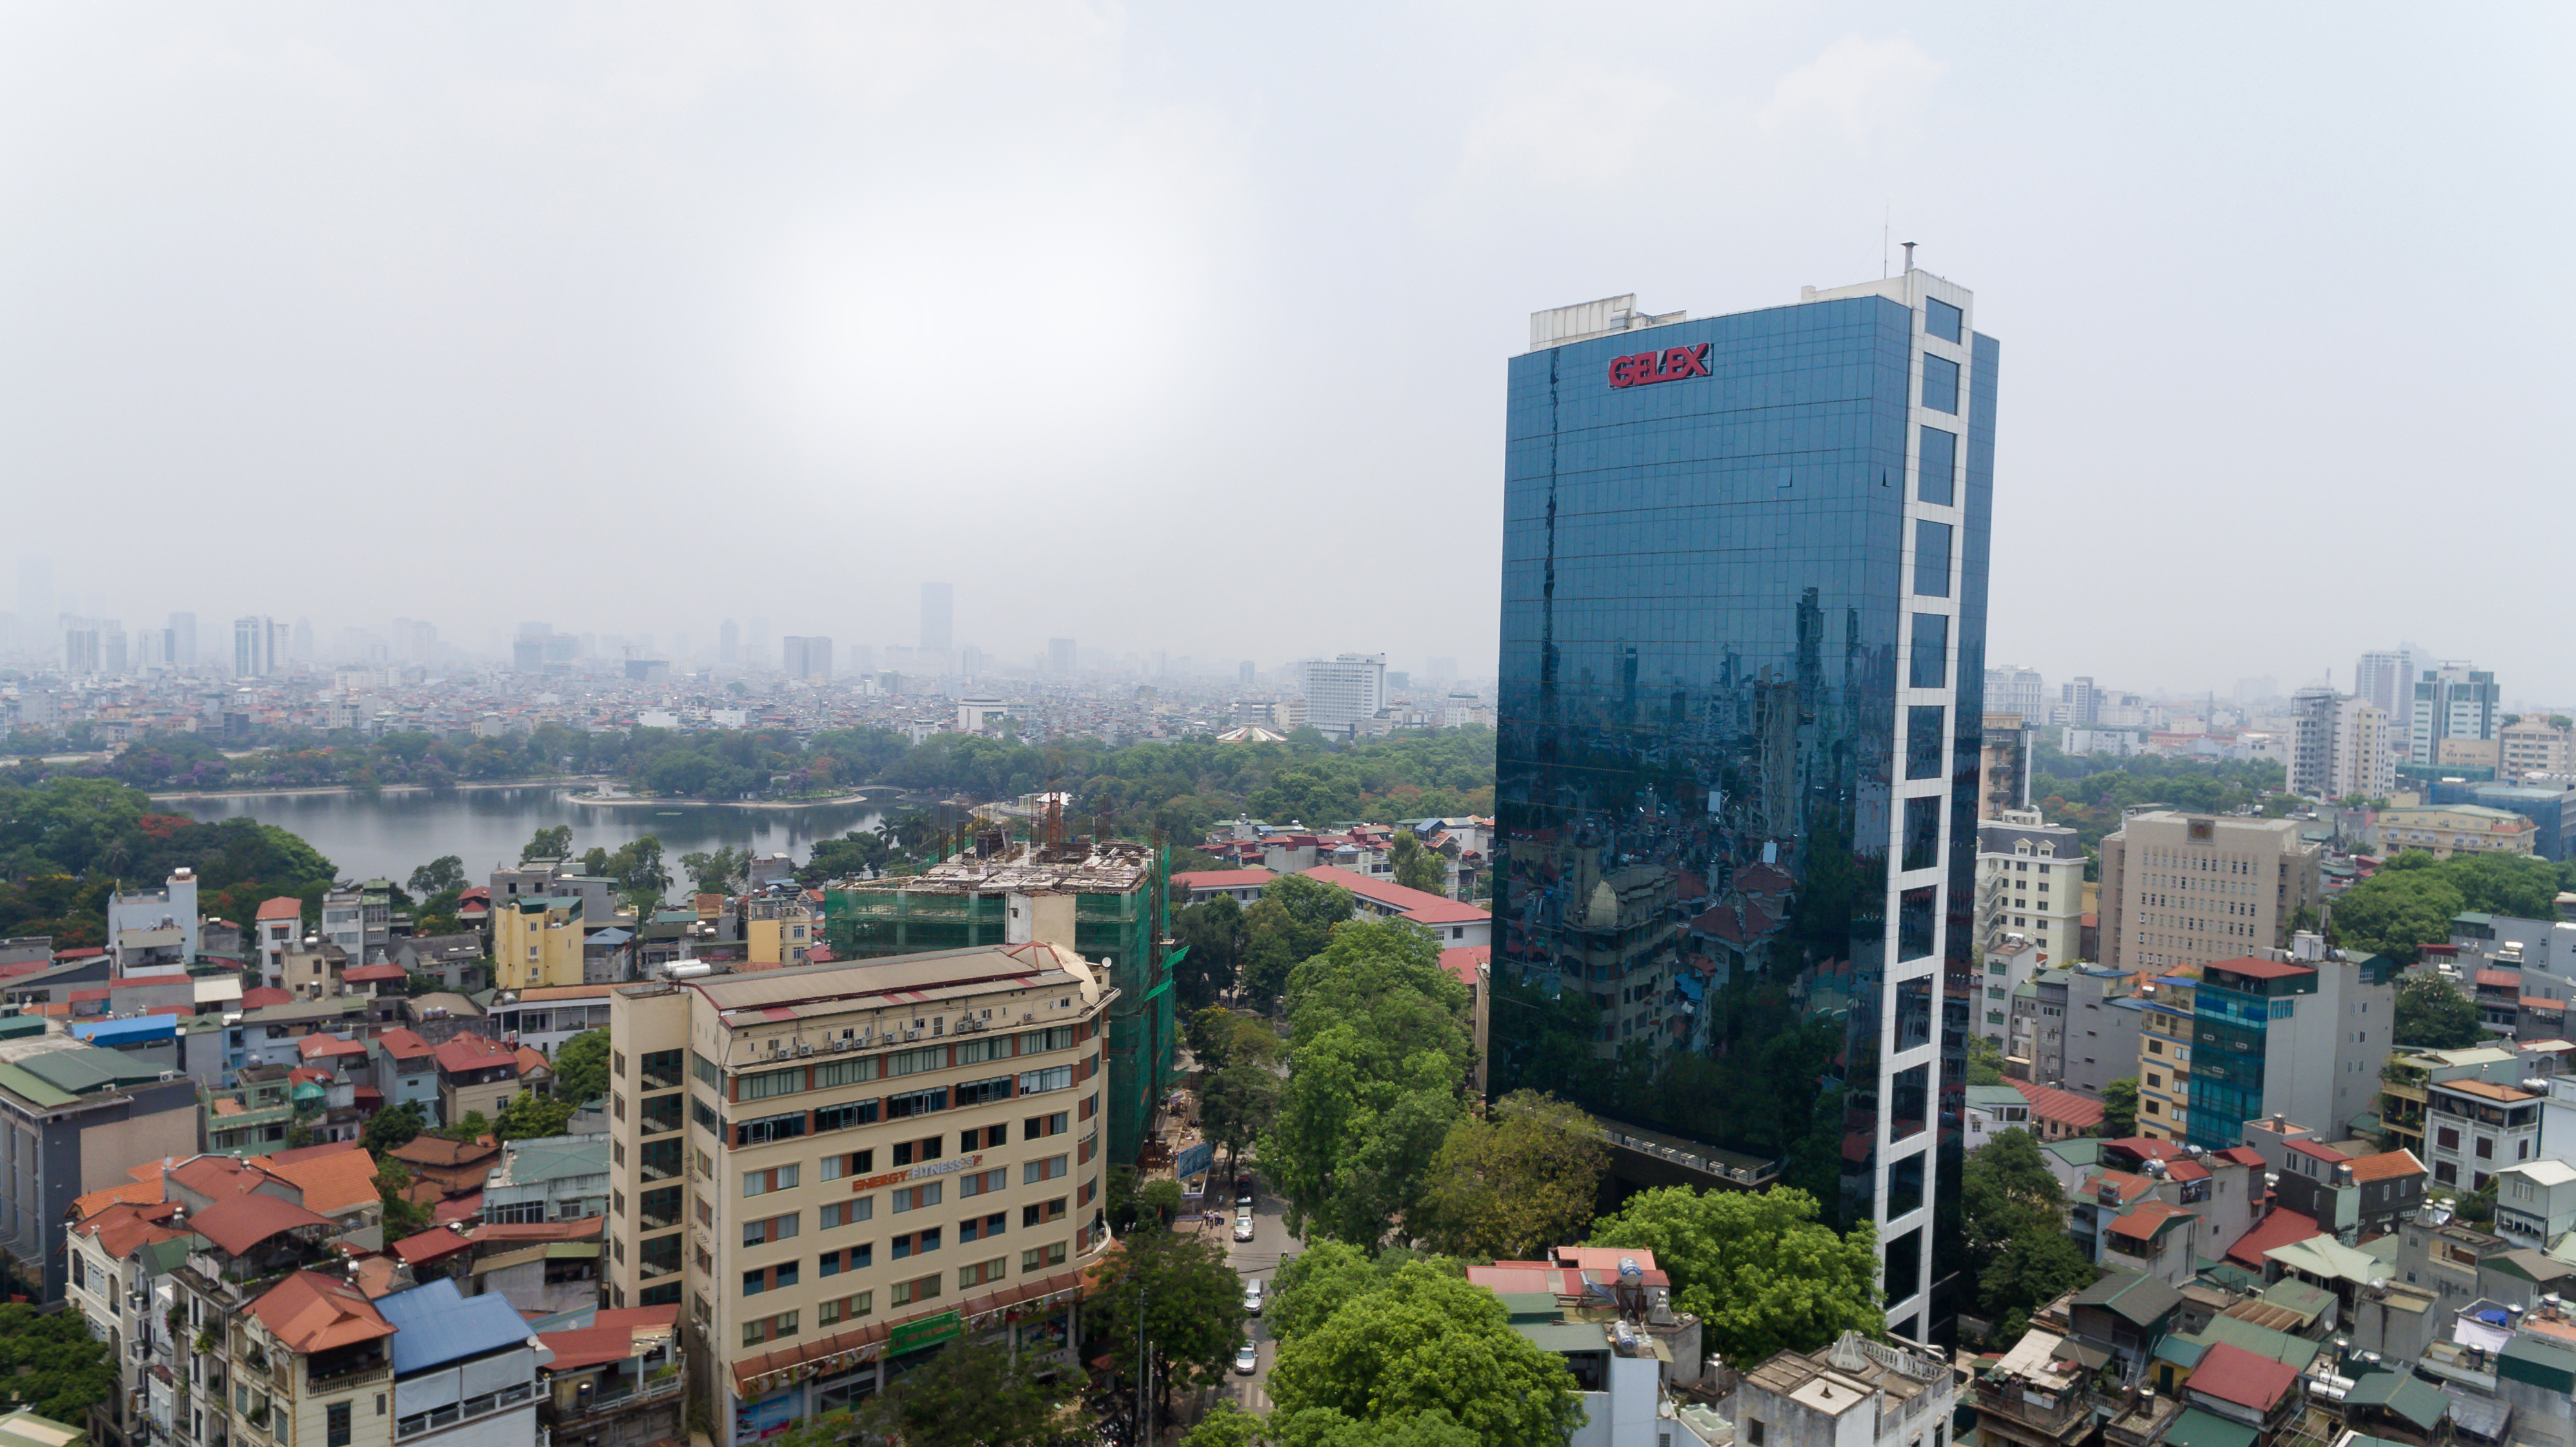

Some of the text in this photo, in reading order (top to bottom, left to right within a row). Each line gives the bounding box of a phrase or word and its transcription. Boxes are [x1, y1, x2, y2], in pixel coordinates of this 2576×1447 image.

[1608, 342, 1710, 387] GELEX
[852, 1169, 909, 1192] ENERGY
[912, 1159, 963, 1179] FITNESS
